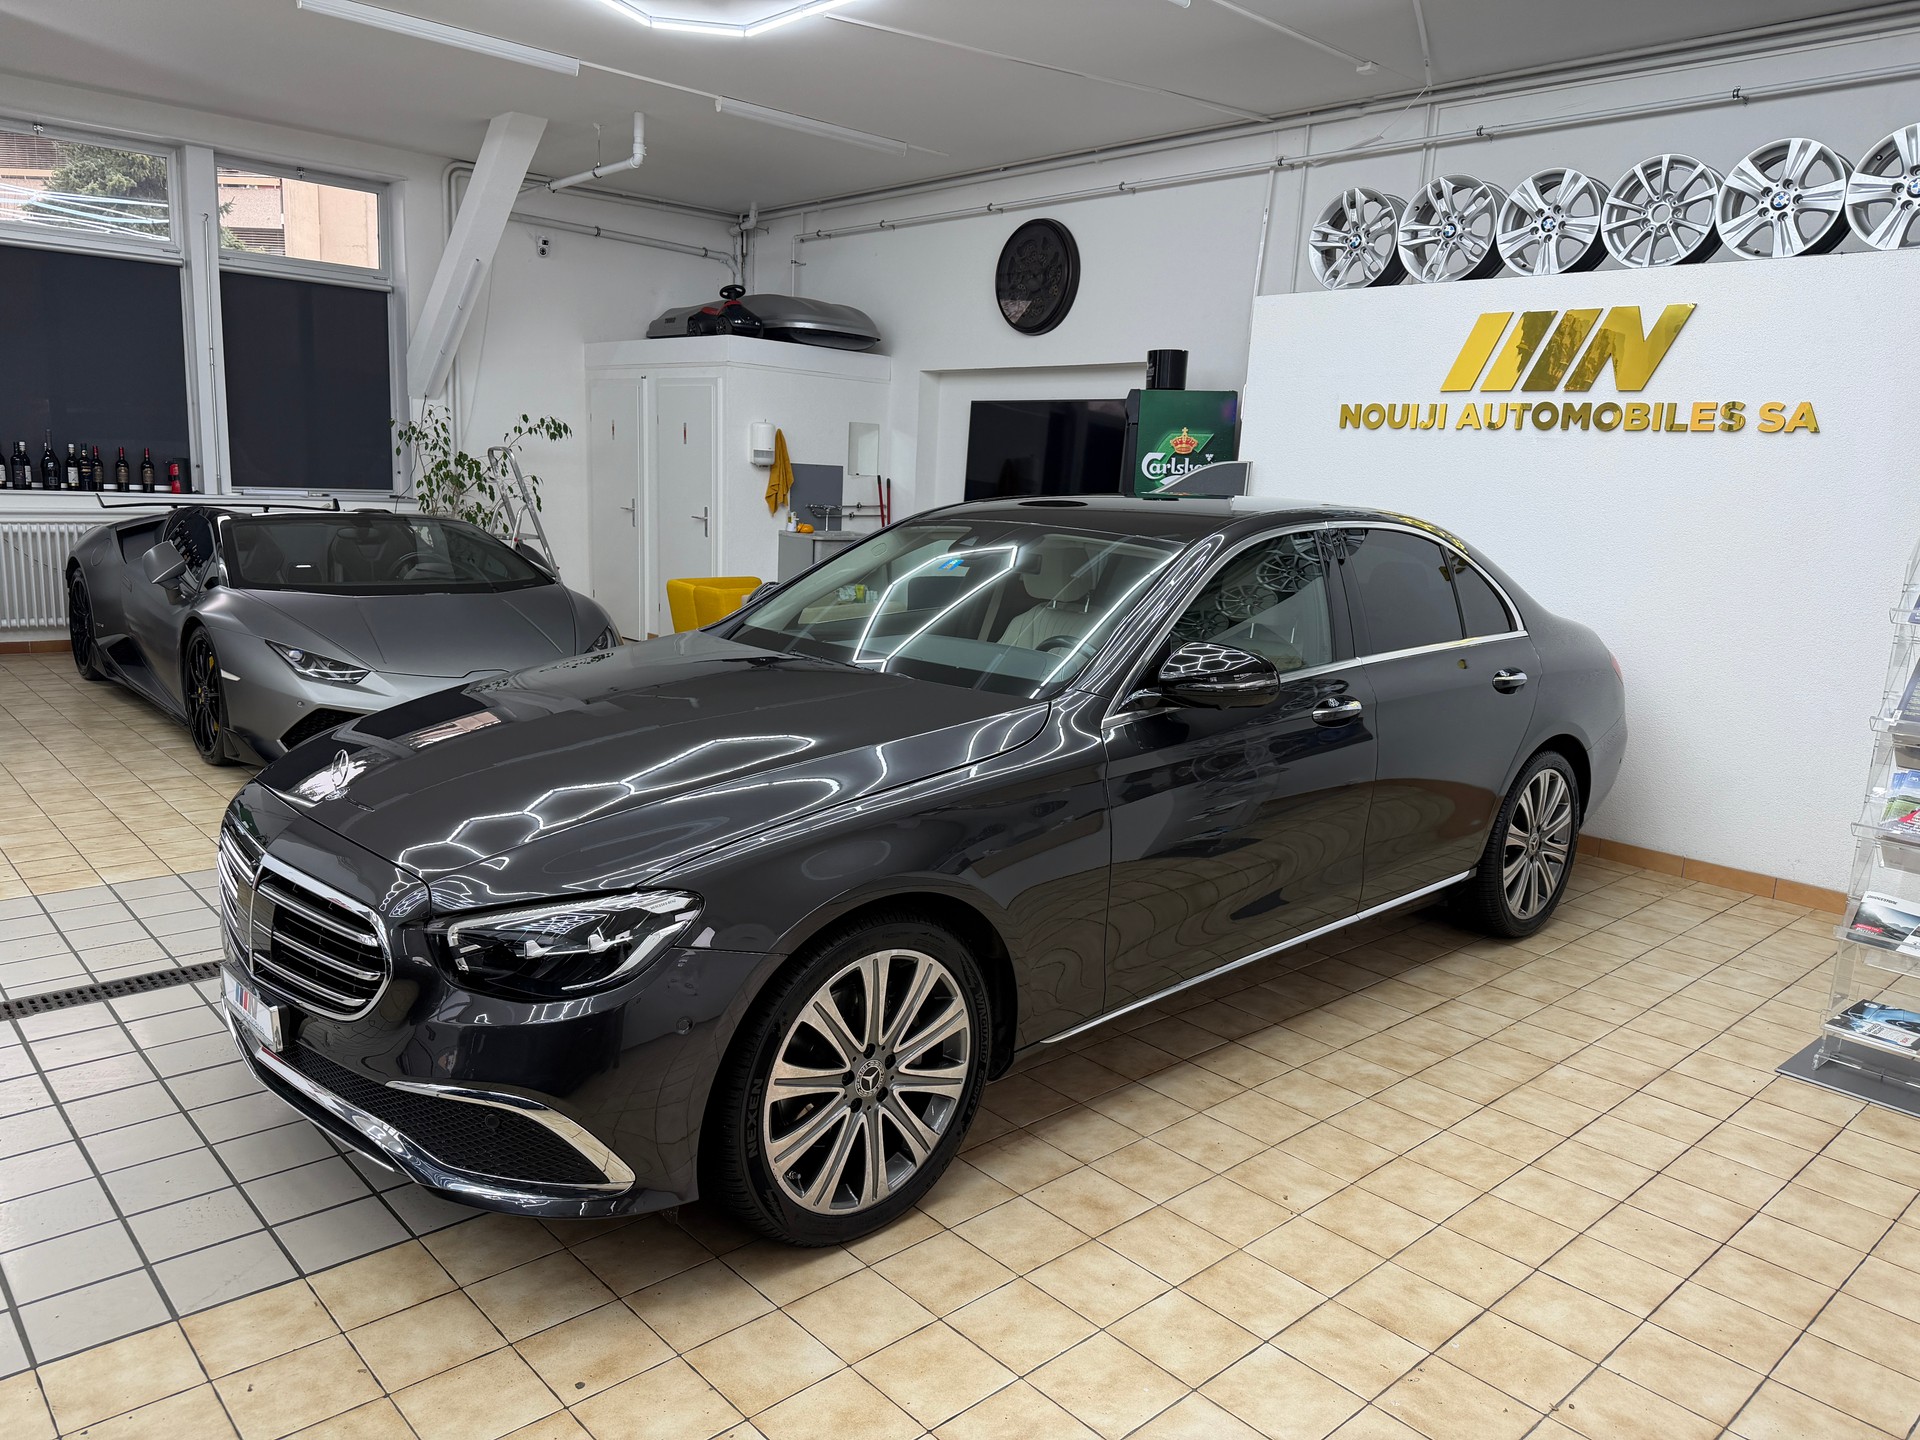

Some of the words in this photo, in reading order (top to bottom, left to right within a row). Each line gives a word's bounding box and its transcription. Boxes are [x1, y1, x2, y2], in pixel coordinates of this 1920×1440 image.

[1338, 402, 1448, 430] NOUIJI
[1455, 401, 1747, 433] AUTOMOBILES
[1757, 401, 1820, 434] SA
[746, 1078, 765, 1160] NEXEN
